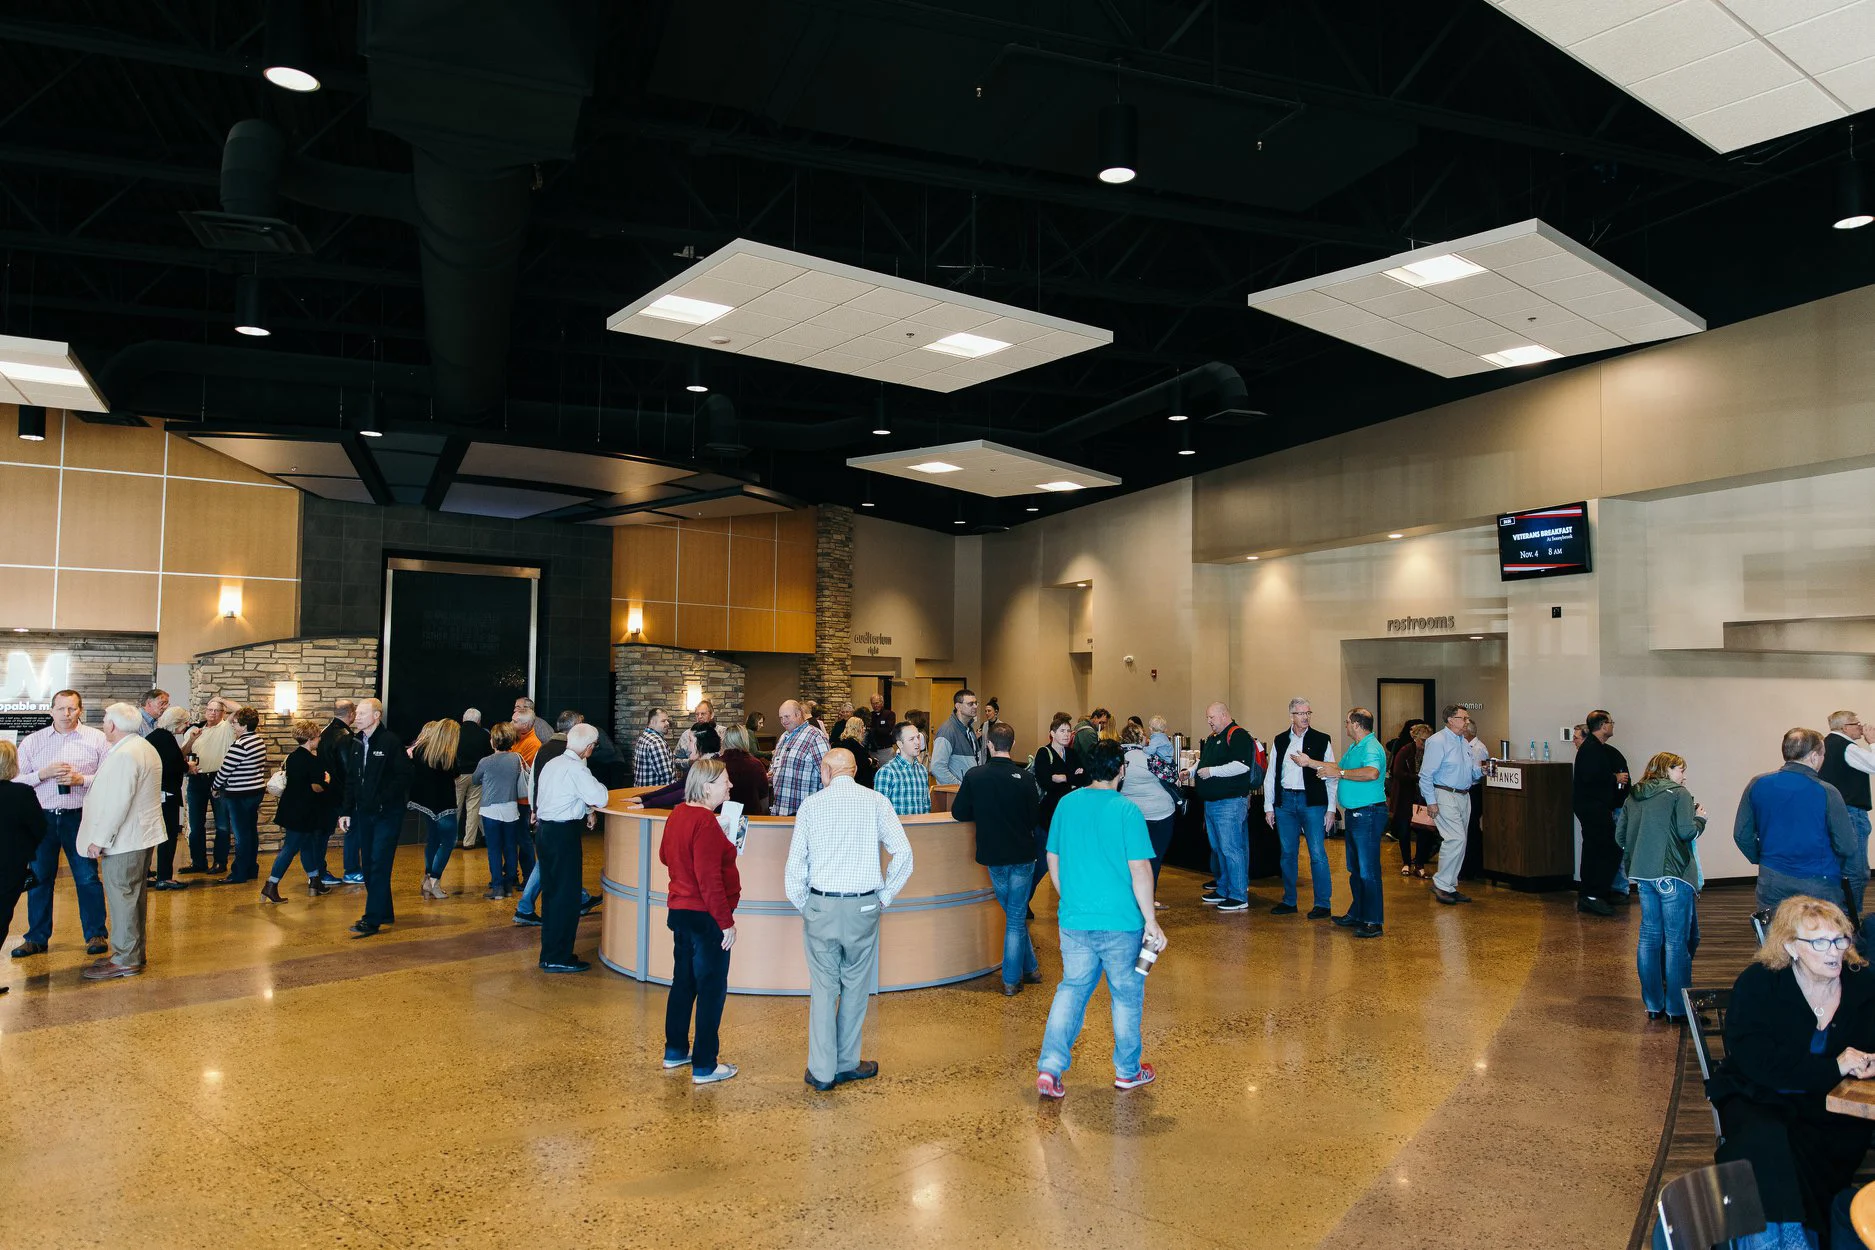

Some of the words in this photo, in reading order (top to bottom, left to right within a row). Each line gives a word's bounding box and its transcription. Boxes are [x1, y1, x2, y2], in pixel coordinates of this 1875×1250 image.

[1512, 530, 1540, 541] VETERANS
[1540, 526, 1573, 537] BREAKFAST
[1534, 550, 1539, 558] 4
[1548, 548, 1552, 556] 8
[1387, 616, 1455, 631] restrooms
[854, 632, 892, 645] auditorium
